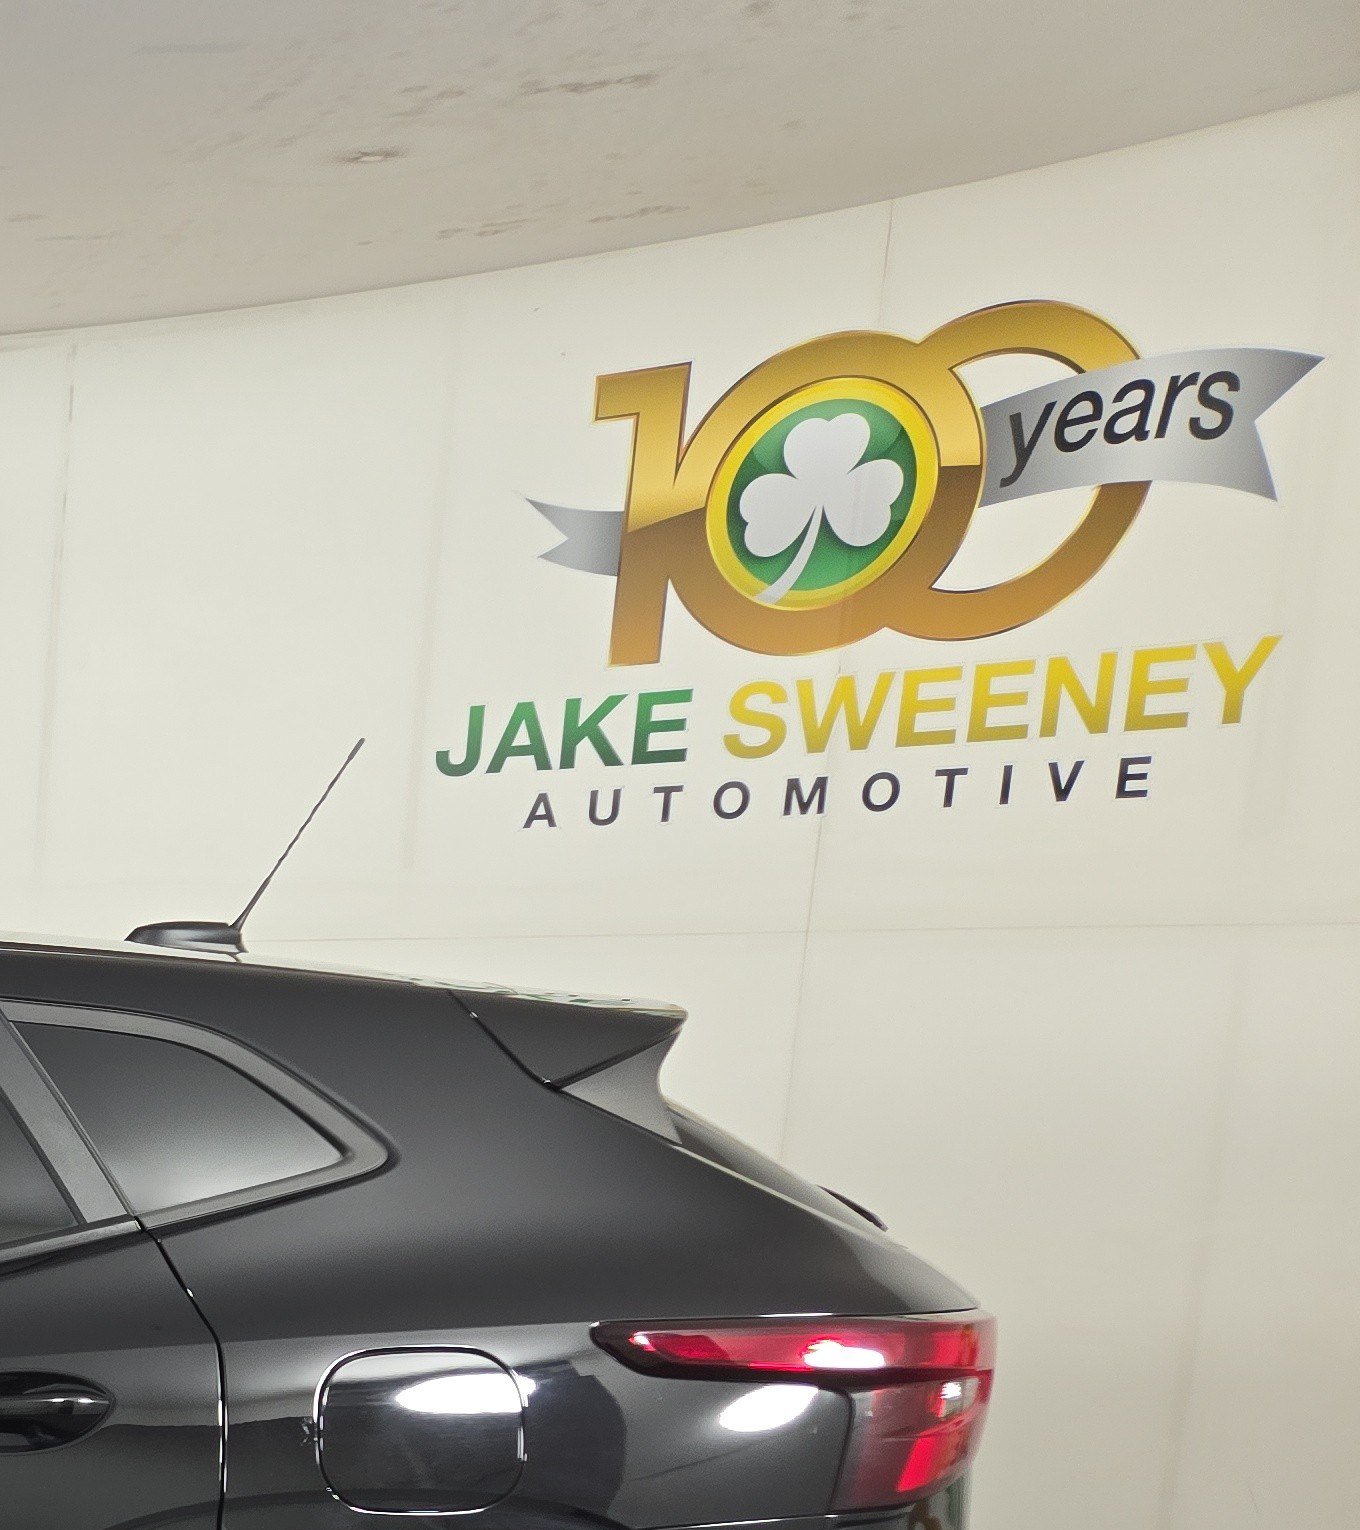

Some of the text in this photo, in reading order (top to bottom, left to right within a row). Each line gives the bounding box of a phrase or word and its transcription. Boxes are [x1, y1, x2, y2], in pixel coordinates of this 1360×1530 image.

[592, 299, 1240, 667] 100 years
[435, 634, 1283, 778] JAKE SWEENEY
[523, 755, 1152, 829] AUTOMOTIVE
